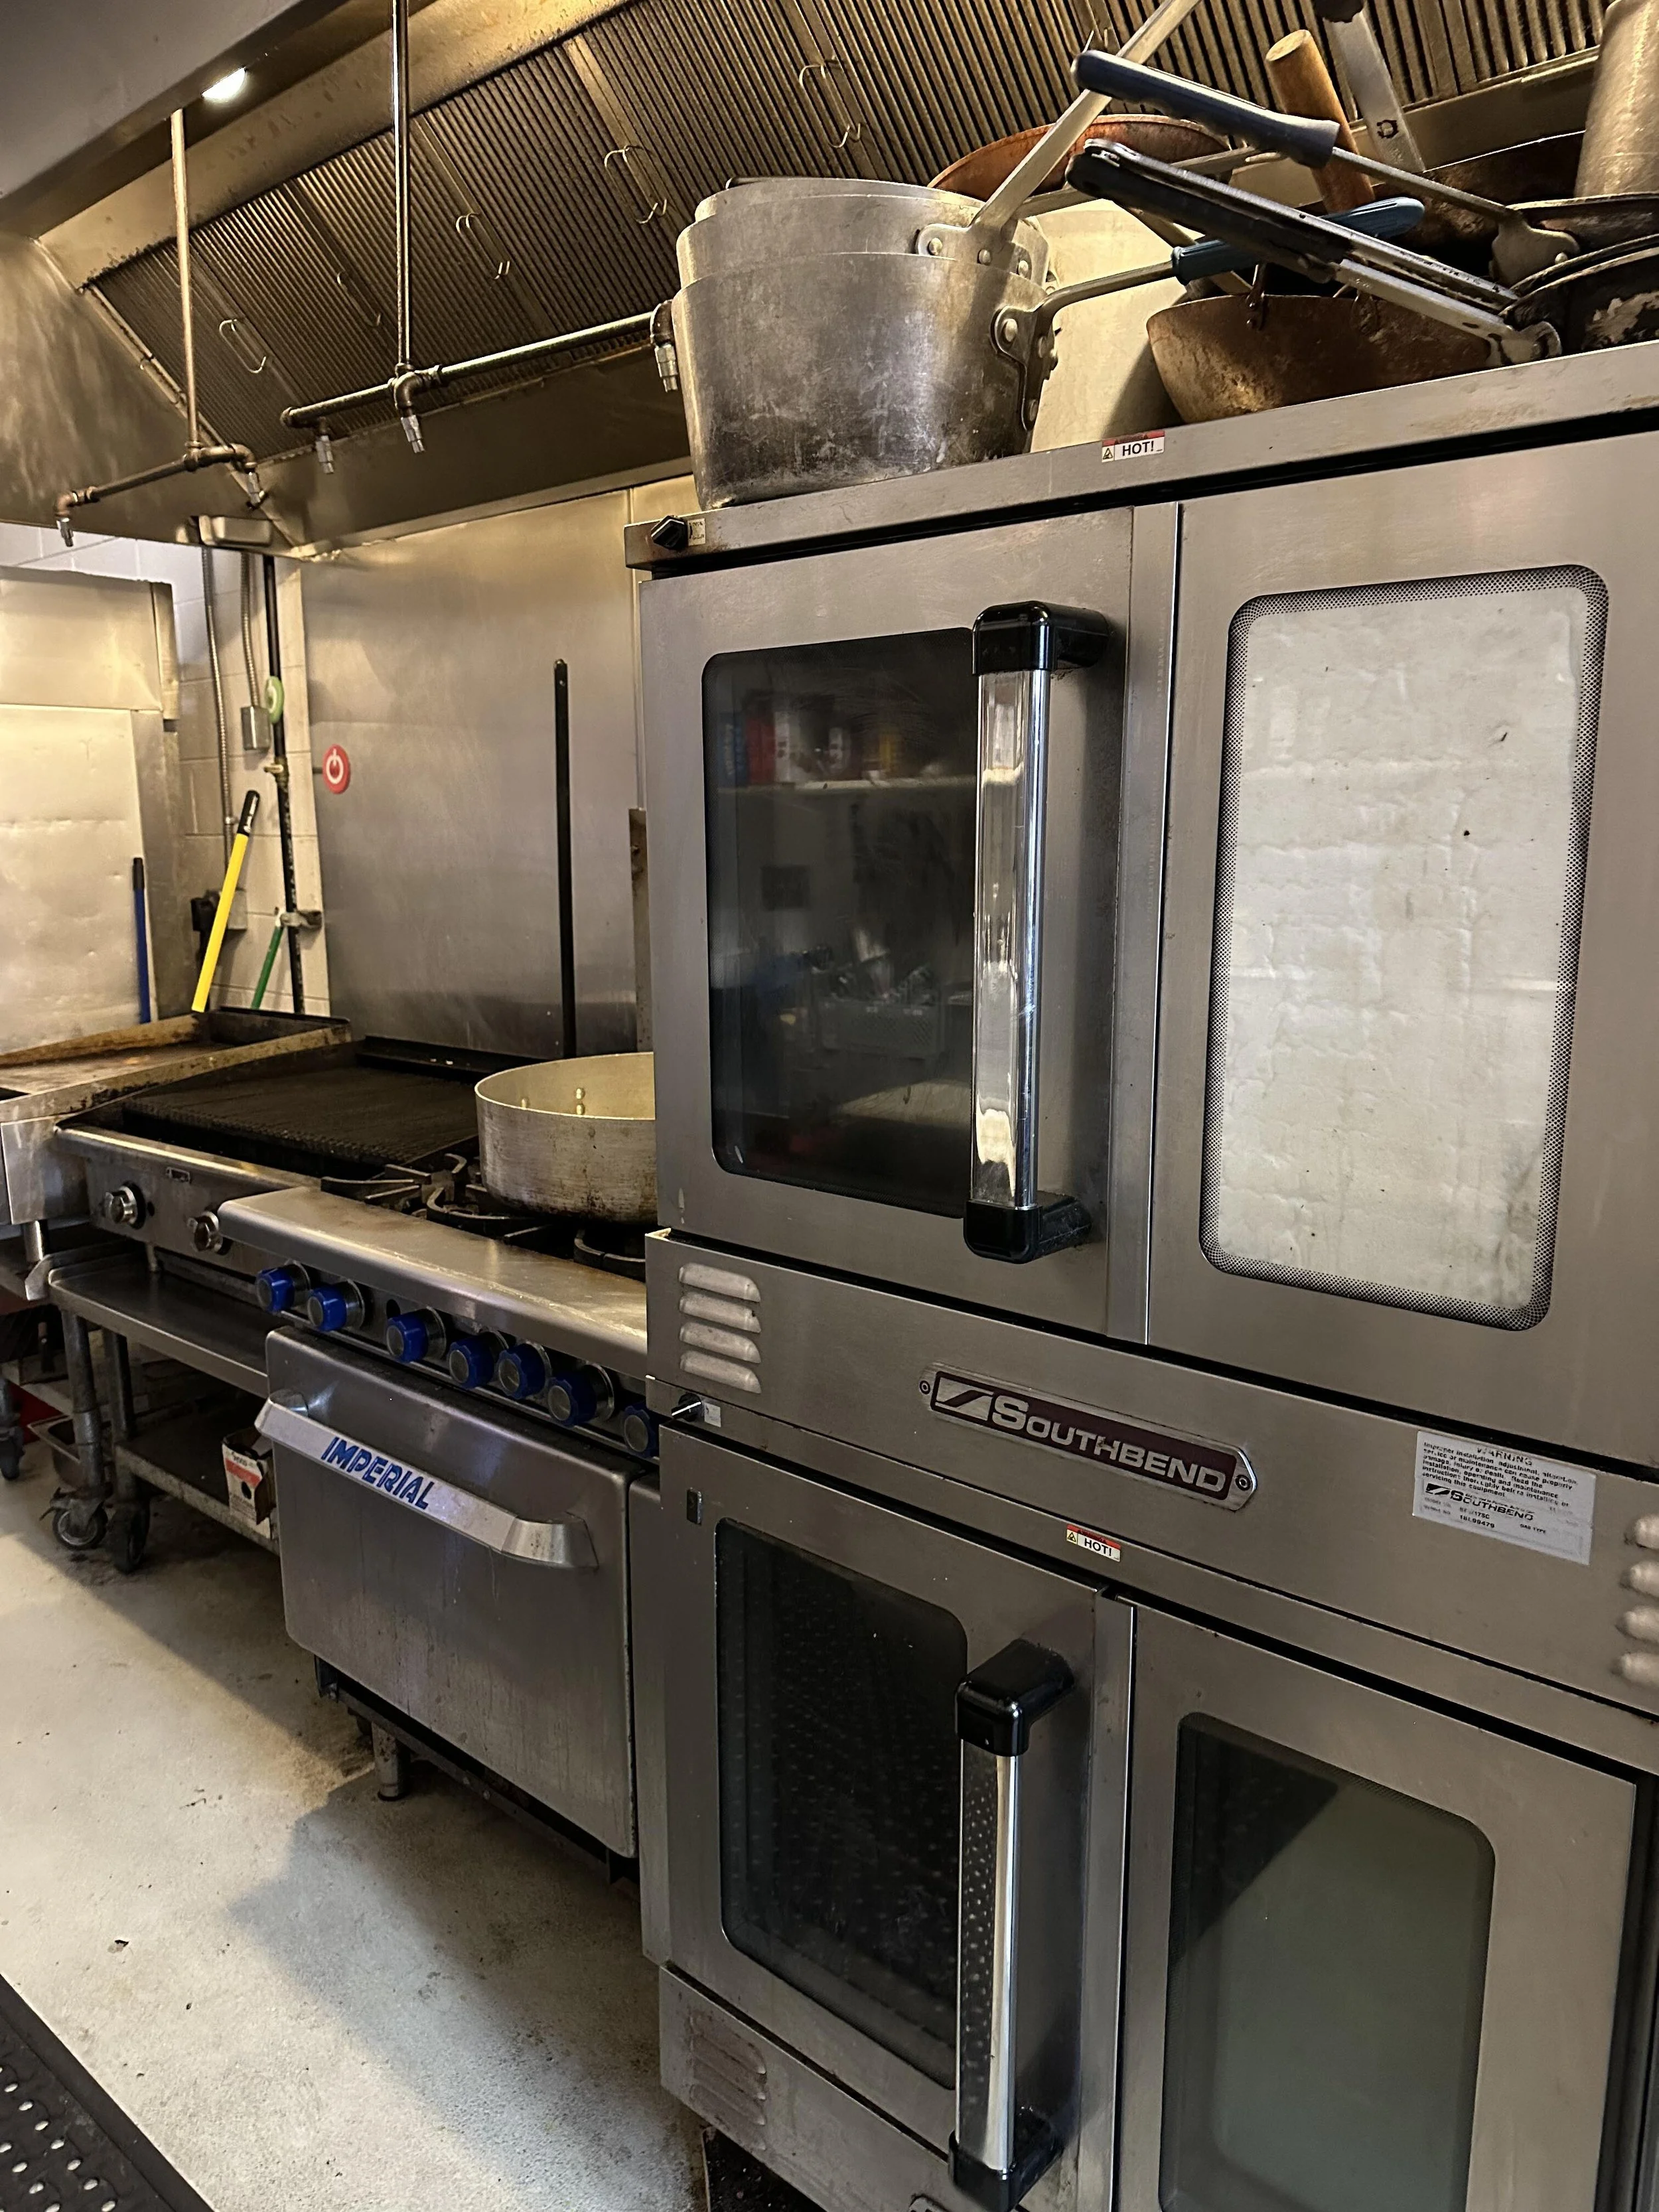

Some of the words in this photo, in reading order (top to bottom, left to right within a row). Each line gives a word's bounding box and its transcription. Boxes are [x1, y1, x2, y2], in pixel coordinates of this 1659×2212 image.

[1122, 441, 1154, 456] HOT!
[321, 1437, 434, 1509] IMPERIAL
[1084, 1538, 1112, 1556] HOT!
